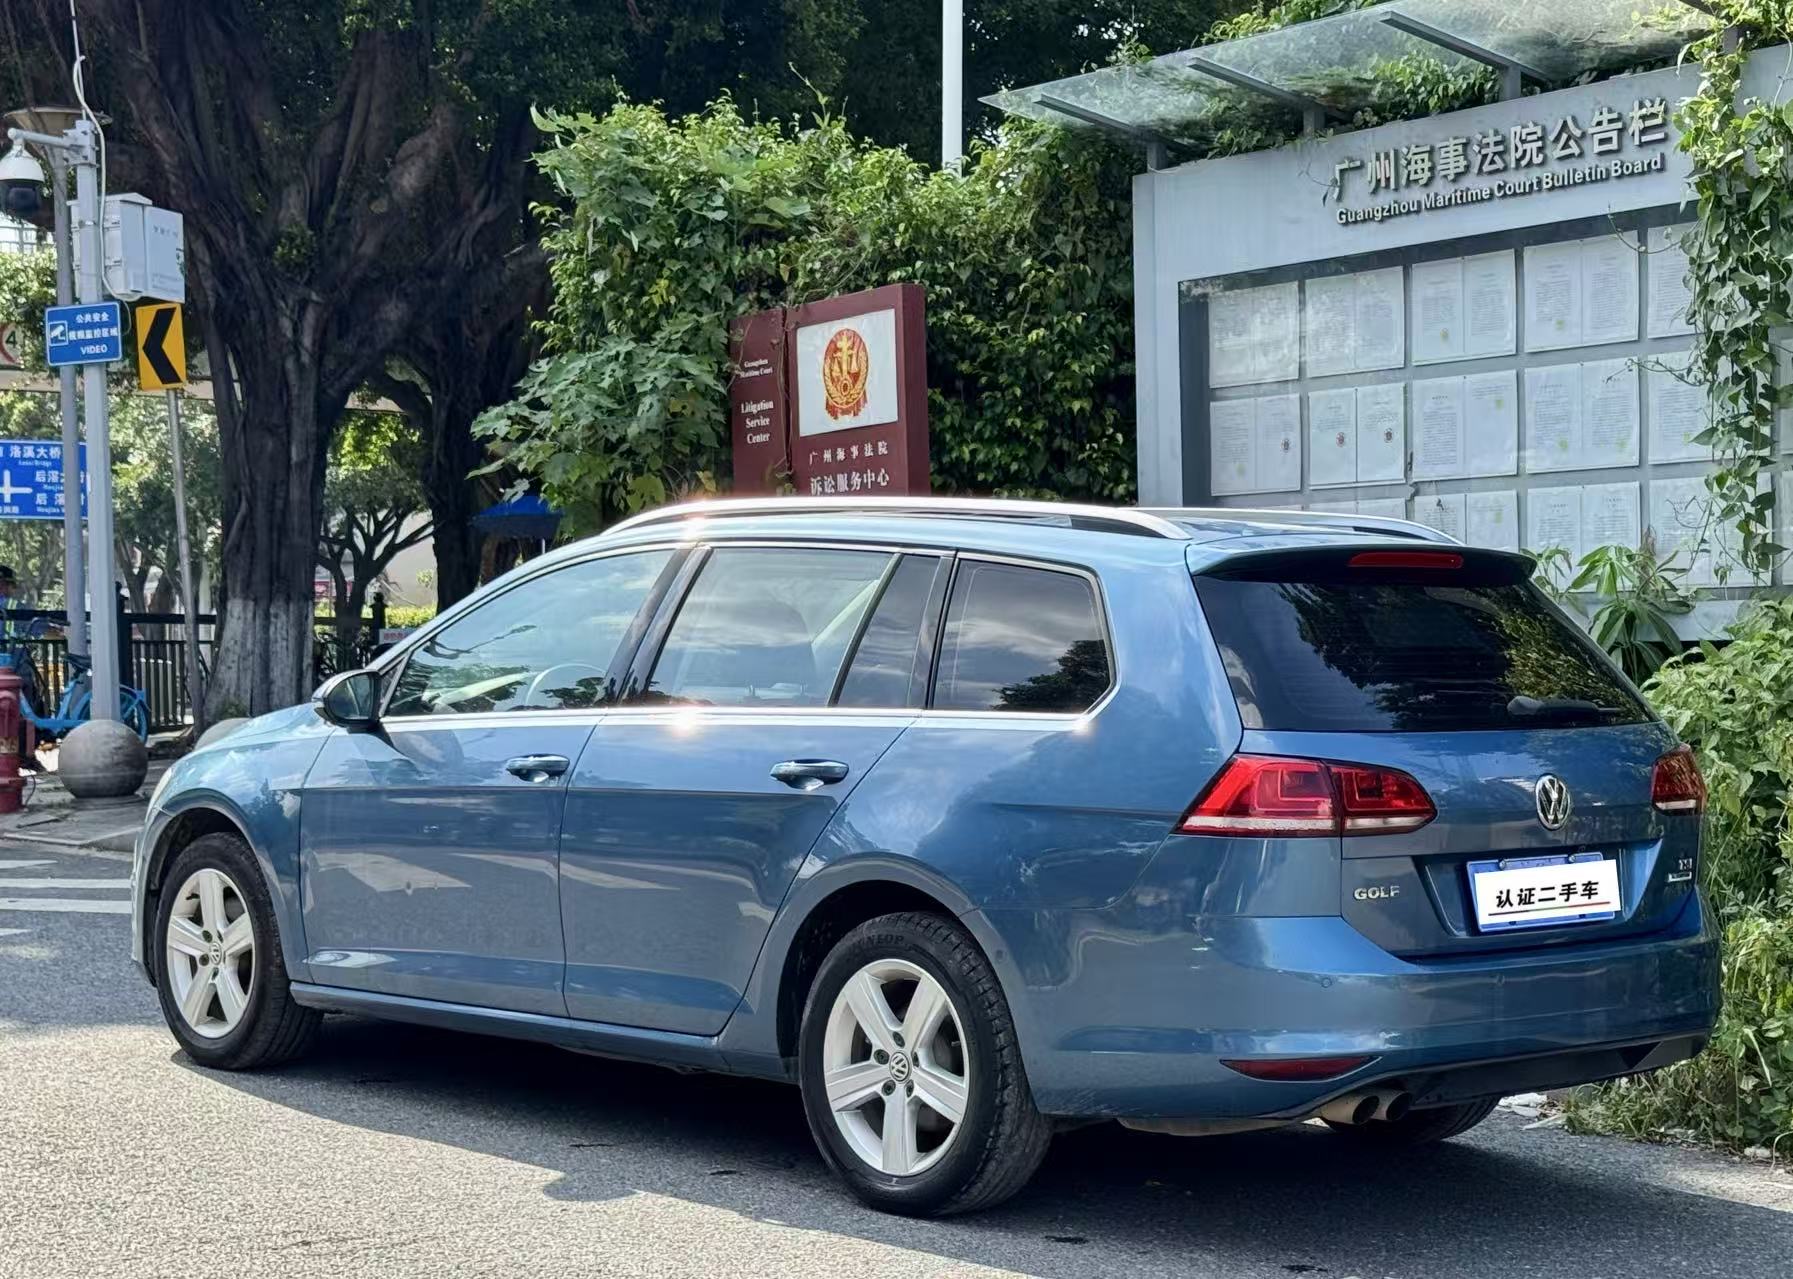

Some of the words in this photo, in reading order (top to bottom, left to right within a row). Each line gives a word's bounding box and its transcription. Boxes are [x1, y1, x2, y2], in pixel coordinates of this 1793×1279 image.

[1333, 97, 1666, 200] 广州海事法院公告栏
[1336, 199, 1418, 225] Guangzhou
[1422, 184, 1491, 210] Maritime
[1494, 176, 1540, 198] Court
[1542, 164, 1607, 190] Bulletin
[1610, 152, 1662, 178] Board
[80, 343, 108, 355] VIDEO
[740, 400, 774, 414] Litigation
[745, 415, 770, 429] Service
[746, 433, 771, 444] Center
[809, 440, 889, 466] 广州海事法院
[810, 467, 890, 496] 诉讼服务中心
[1353, 885, 1401, 900] GOLF
